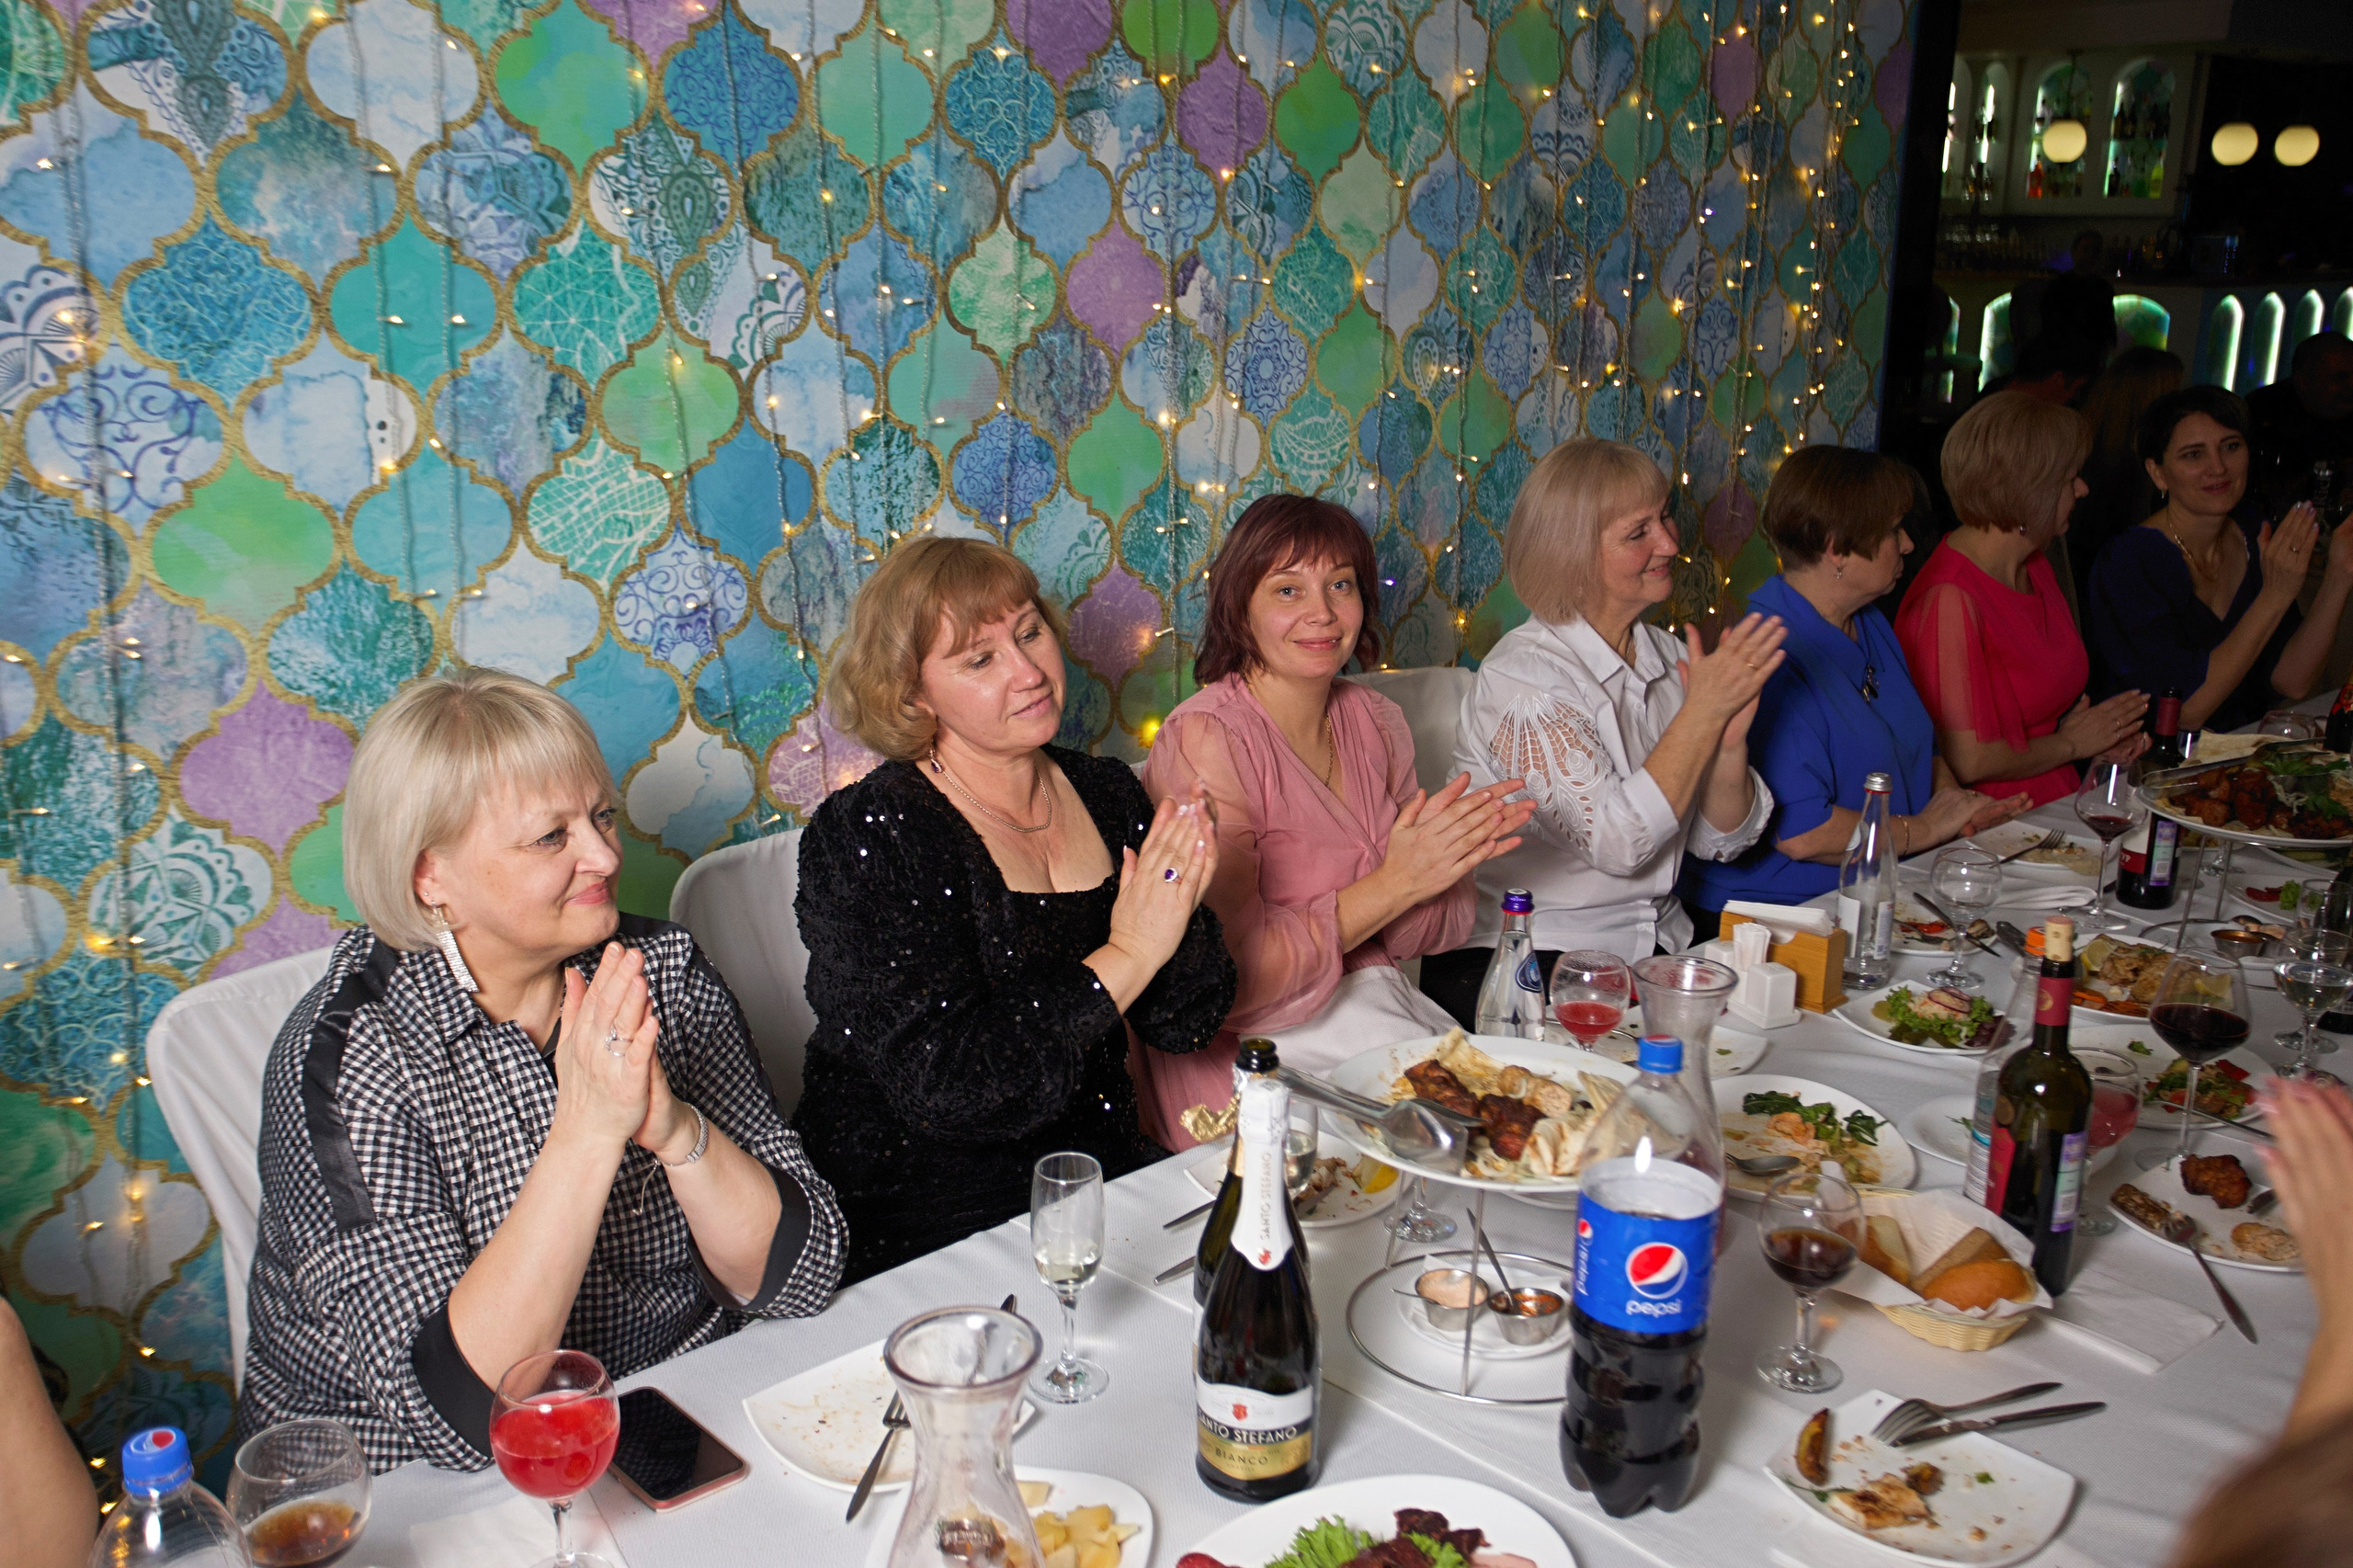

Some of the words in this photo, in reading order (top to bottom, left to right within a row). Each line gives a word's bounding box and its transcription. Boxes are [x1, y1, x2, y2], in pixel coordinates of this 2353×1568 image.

[1260, 1153, 1272, 1200] STEFANO
[1259, 1202, 1271, 1241] SANTO
[1576, 1243, 1590, 1297] pepsi
[1625, 1299, 1683, 1319] pepsi
[1233, 1425, 1298, 1445] STEFANO
[1215, 1448, 1268, 1466] BIANCO
